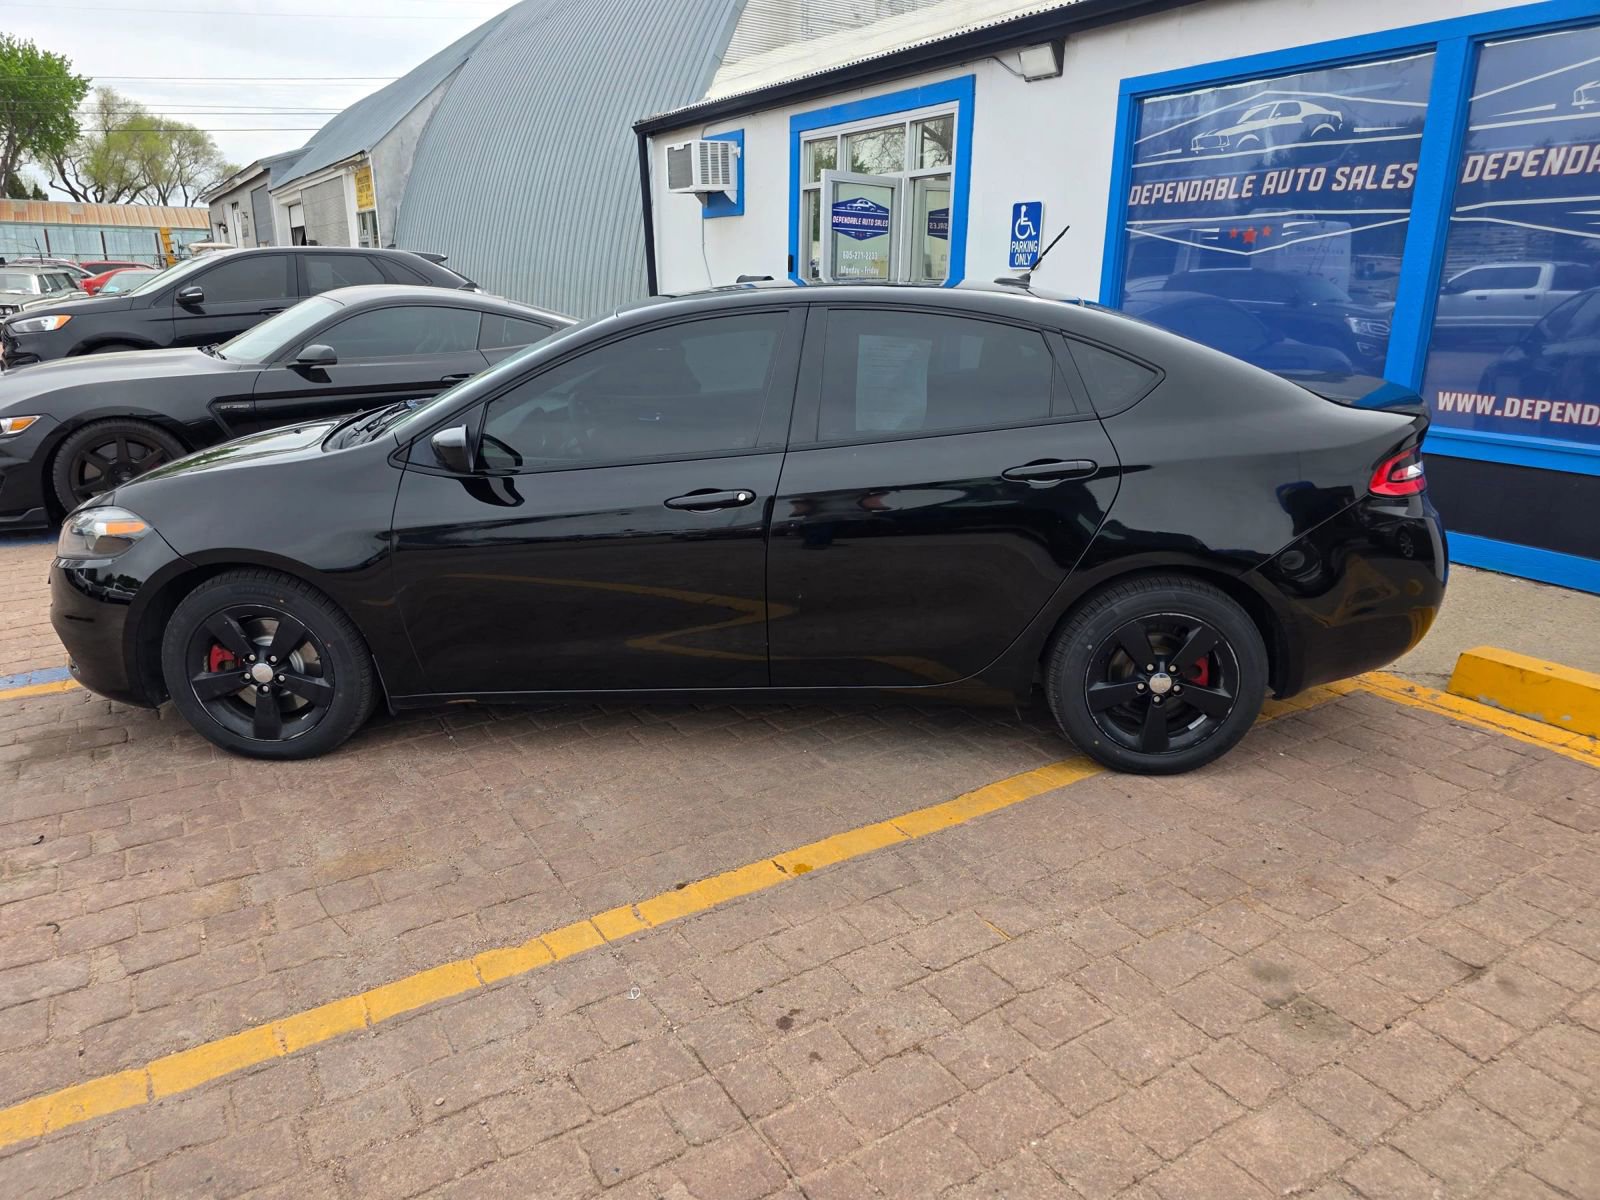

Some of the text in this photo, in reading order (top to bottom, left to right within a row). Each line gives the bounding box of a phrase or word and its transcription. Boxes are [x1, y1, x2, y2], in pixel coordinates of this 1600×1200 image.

[1128, 162, 1418, 206] DEPENDABLE AUTO SALES
[832, 216, 861, 225] DEPENDABLE
[862, 217, 874, 226] AUTO
[1011, 240, 1038, 253] PARKING
[1015, 253, 1033, 266] ONLY
[840, 265, 860, 275] Monday
[1437, 391, 1600, 426] WWW.DEPEND
